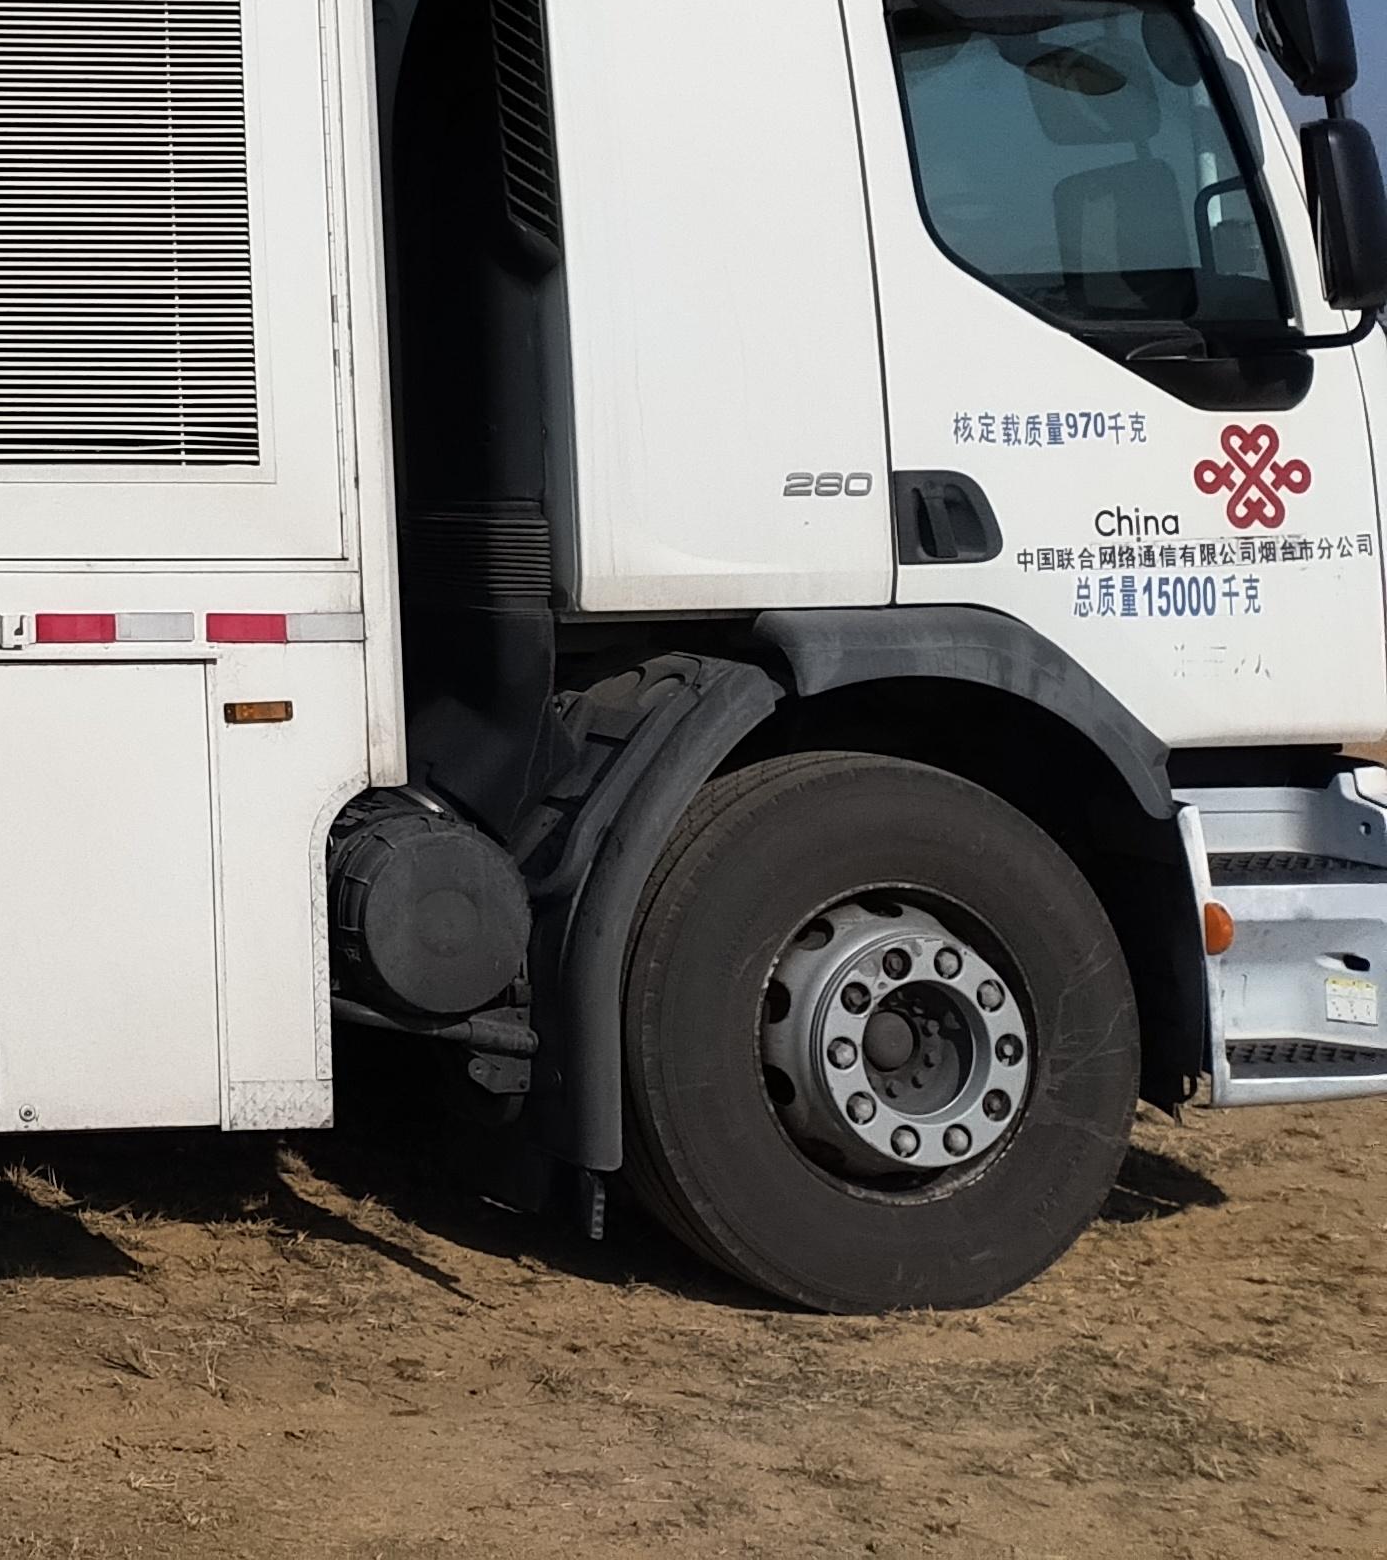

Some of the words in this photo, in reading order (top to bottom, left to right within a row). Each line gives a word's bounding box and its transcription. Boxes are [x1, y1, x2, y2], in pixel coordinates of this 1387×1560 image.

[954, 412, 1146, 447] 核定载质量970千克
[783, 473, 872, 496] 280
[1095, 507, 1179, 536] China
[1017, 533, 1373, 572] 中国联合网络通信有限公司烟台市分公司
[1074, 575, 1260, 617] 总质量15000千克
